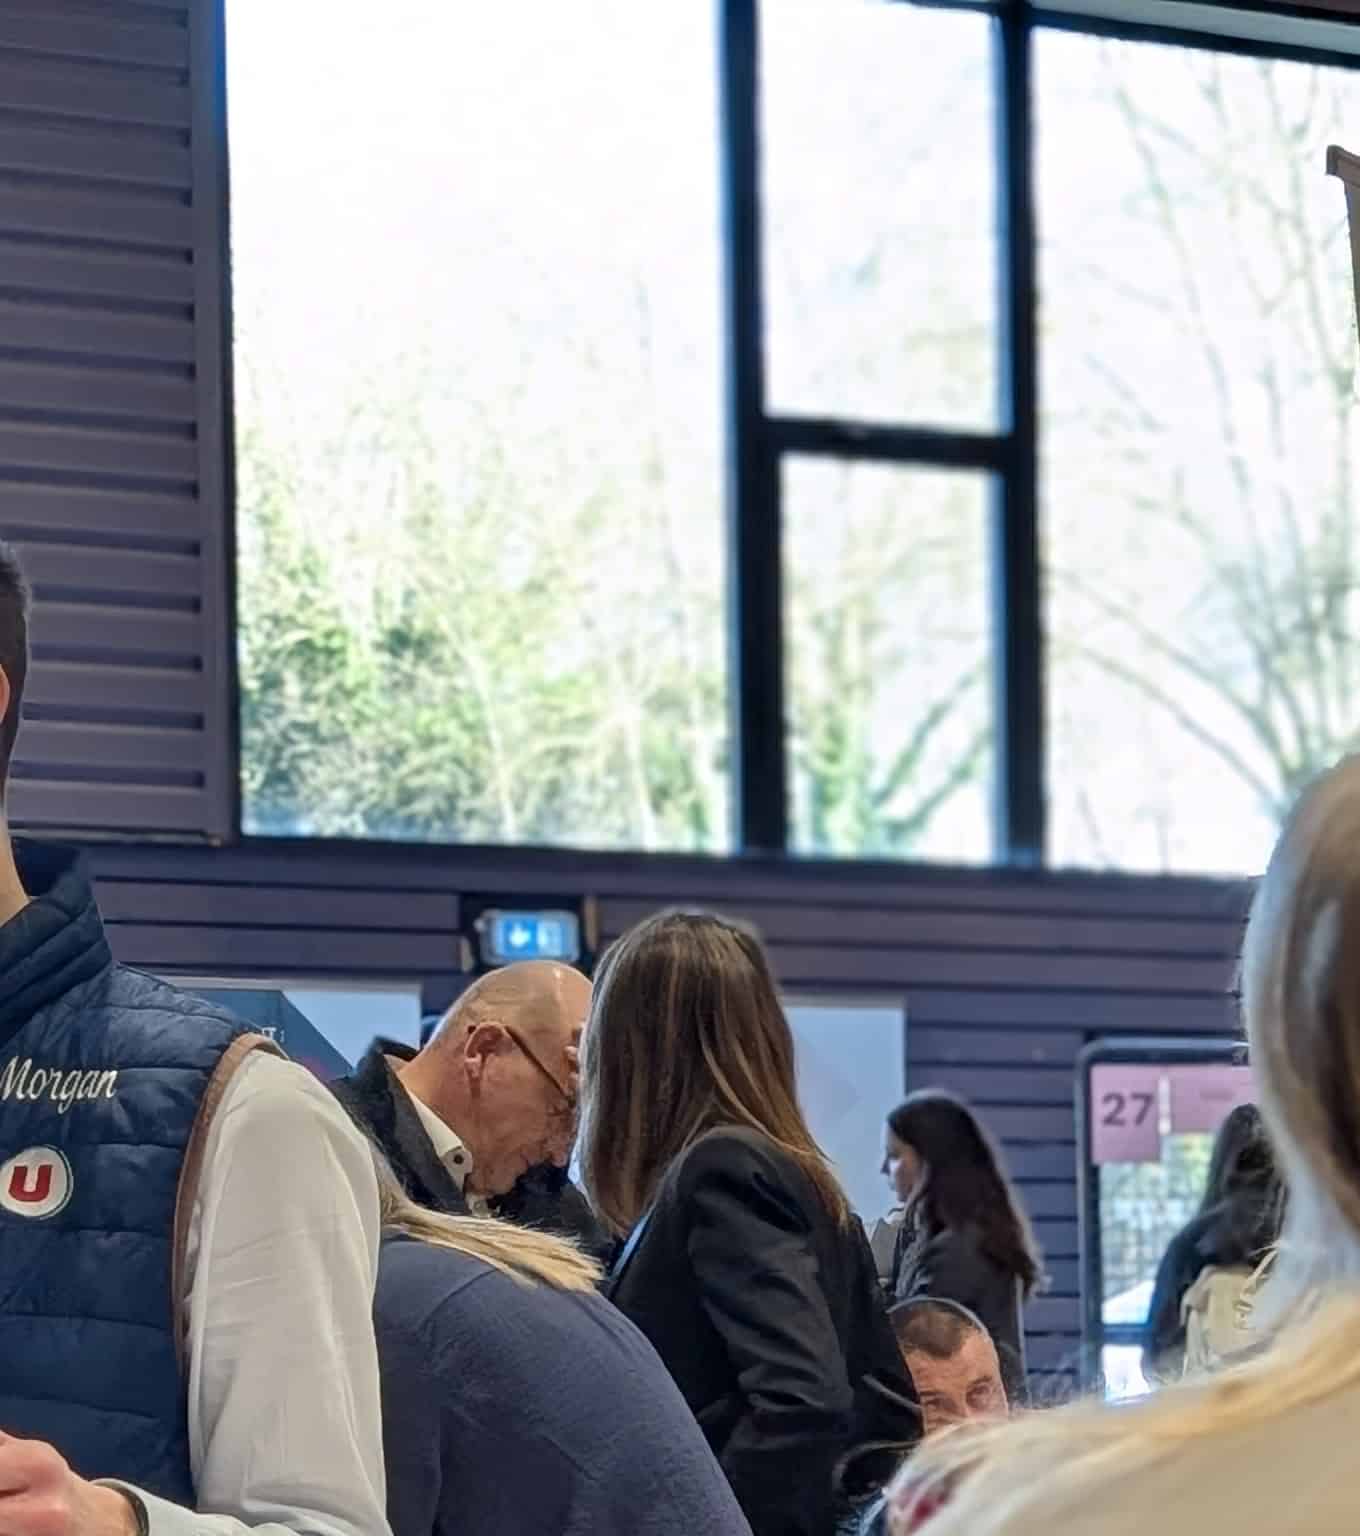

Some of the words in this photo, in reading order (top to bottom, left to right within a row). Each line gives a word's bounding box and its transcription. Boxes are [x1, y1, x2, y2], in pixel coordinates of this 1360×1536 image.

[0, 1056, 118, 1114] Morgan
[1103, 1093, 1153, 1127] 27
[8, 1164, 53, 1202] U
